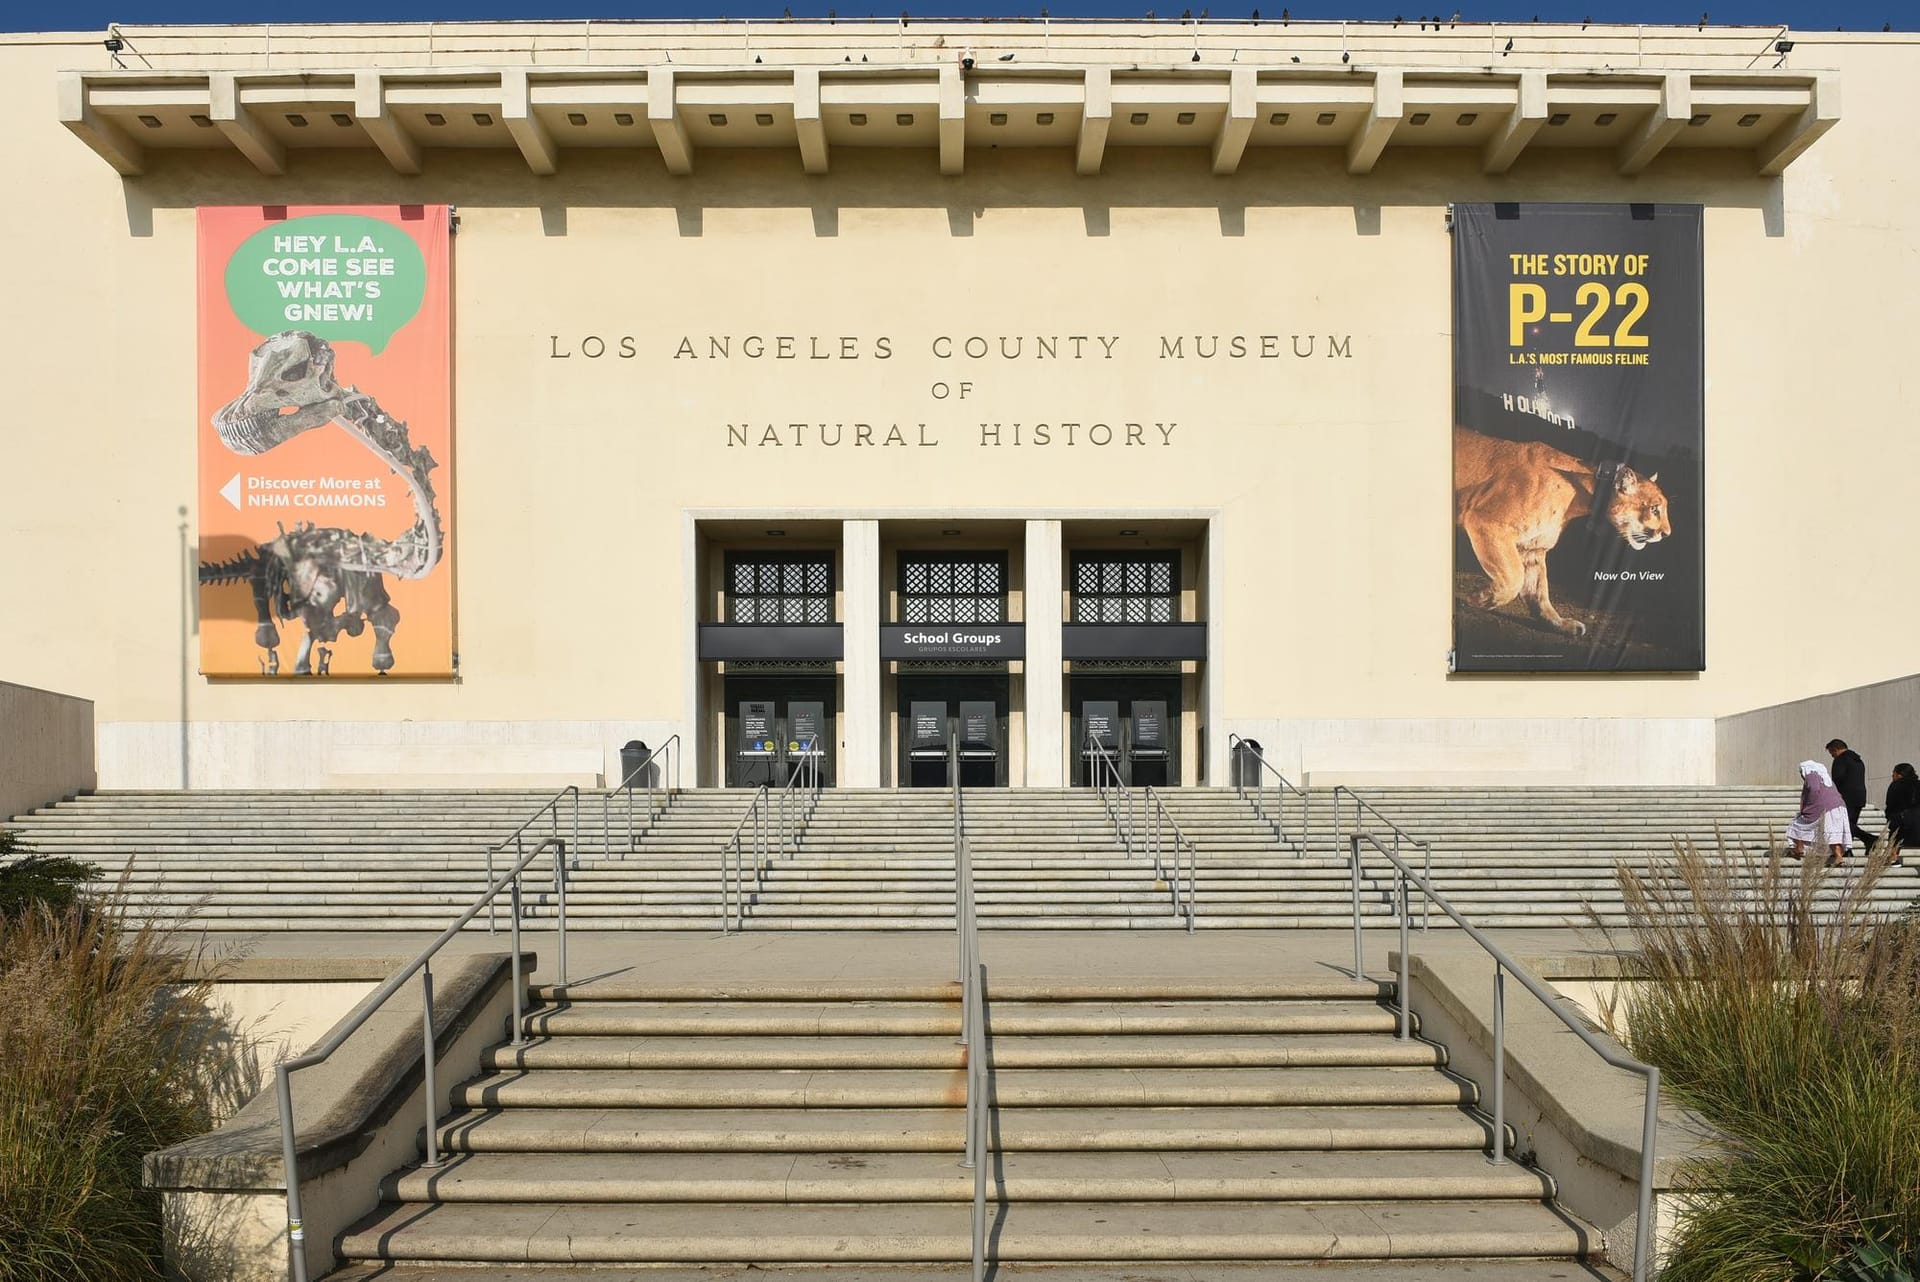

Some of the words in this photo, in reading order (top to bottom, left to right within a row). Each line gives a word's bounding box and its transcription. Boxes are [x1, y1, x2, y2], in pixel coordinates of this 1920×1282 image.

[274, 236, 326, 253] HEY
[335, 236, 384, 253] L.A.
[263, 258, 337, 276] COME
[346, 258, 394, 276] SEE
[1510, 254, 1549, 275] THE
[1554, 254, 1619, 275] STORY
[1624, 254, 1649, 275] OF
[277, 281, 381, 298] WHAT'S
[284, 303, 373, 321] GNEW!
[1509, 282, 1649, 347] P-22
[550, 336, 638, 359] LOS
[674, 336, 893, 359] ANGELES
[932, 336, 1120, 359] COUNTY
[1160, 336, 1353, 359] MUSEUM
[1539, 353, 1569, 364] MOST
[1571, 353, 1613, 364] FAMOUS
[1615, 353, 1649, 365] FELINE
[931, 382, 974, 400] OF
[727, 424, 939, 447] NATURAL
[980, 424, 1178, 447] HISTORY
[248, 477, 316, 490] Discover
[320, 477, 359, 490] More
[364, 478, 381, 490] at
[248, 494, 289, 507] NHM
[293, 494, 386, 507] COMMONS
[1594, 571, 1617, 581] Now
[1621, 571, 1636, 581] On
[1639, 571, 1664, 581] View
[904, 632, 948, 643] School
[952, 633, 1001, 646] Groups
